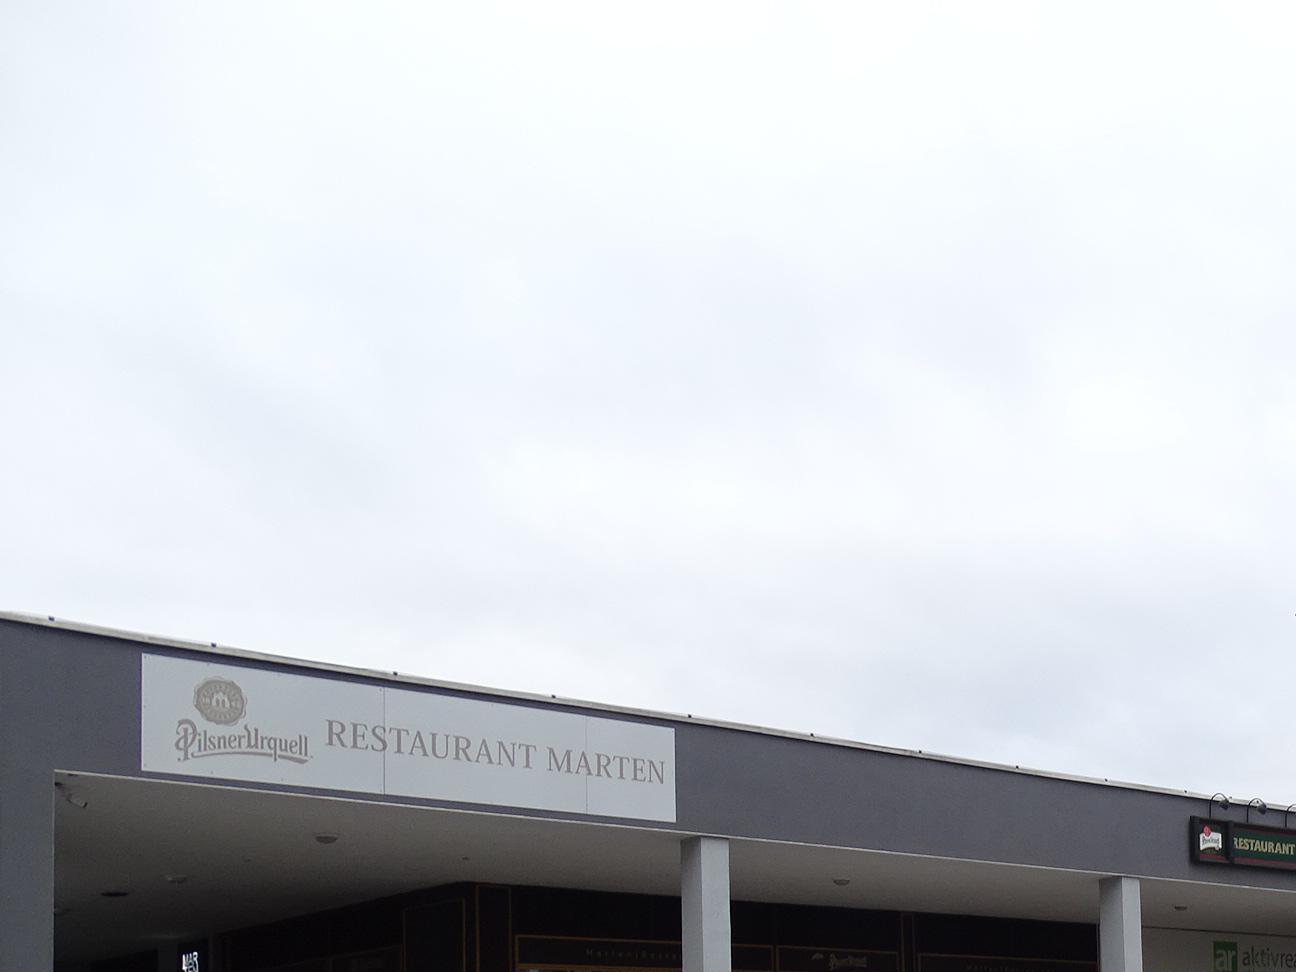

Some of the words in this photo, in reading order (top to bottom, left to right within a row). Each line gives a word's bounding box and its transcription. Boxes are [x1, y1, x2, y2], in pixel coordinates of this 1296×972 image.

[325, 719, 537, 769] RESTAURANT
[546, 746, 665, 785] MARTEN
[1234, 837, 1296, 856] RESTAURANT
